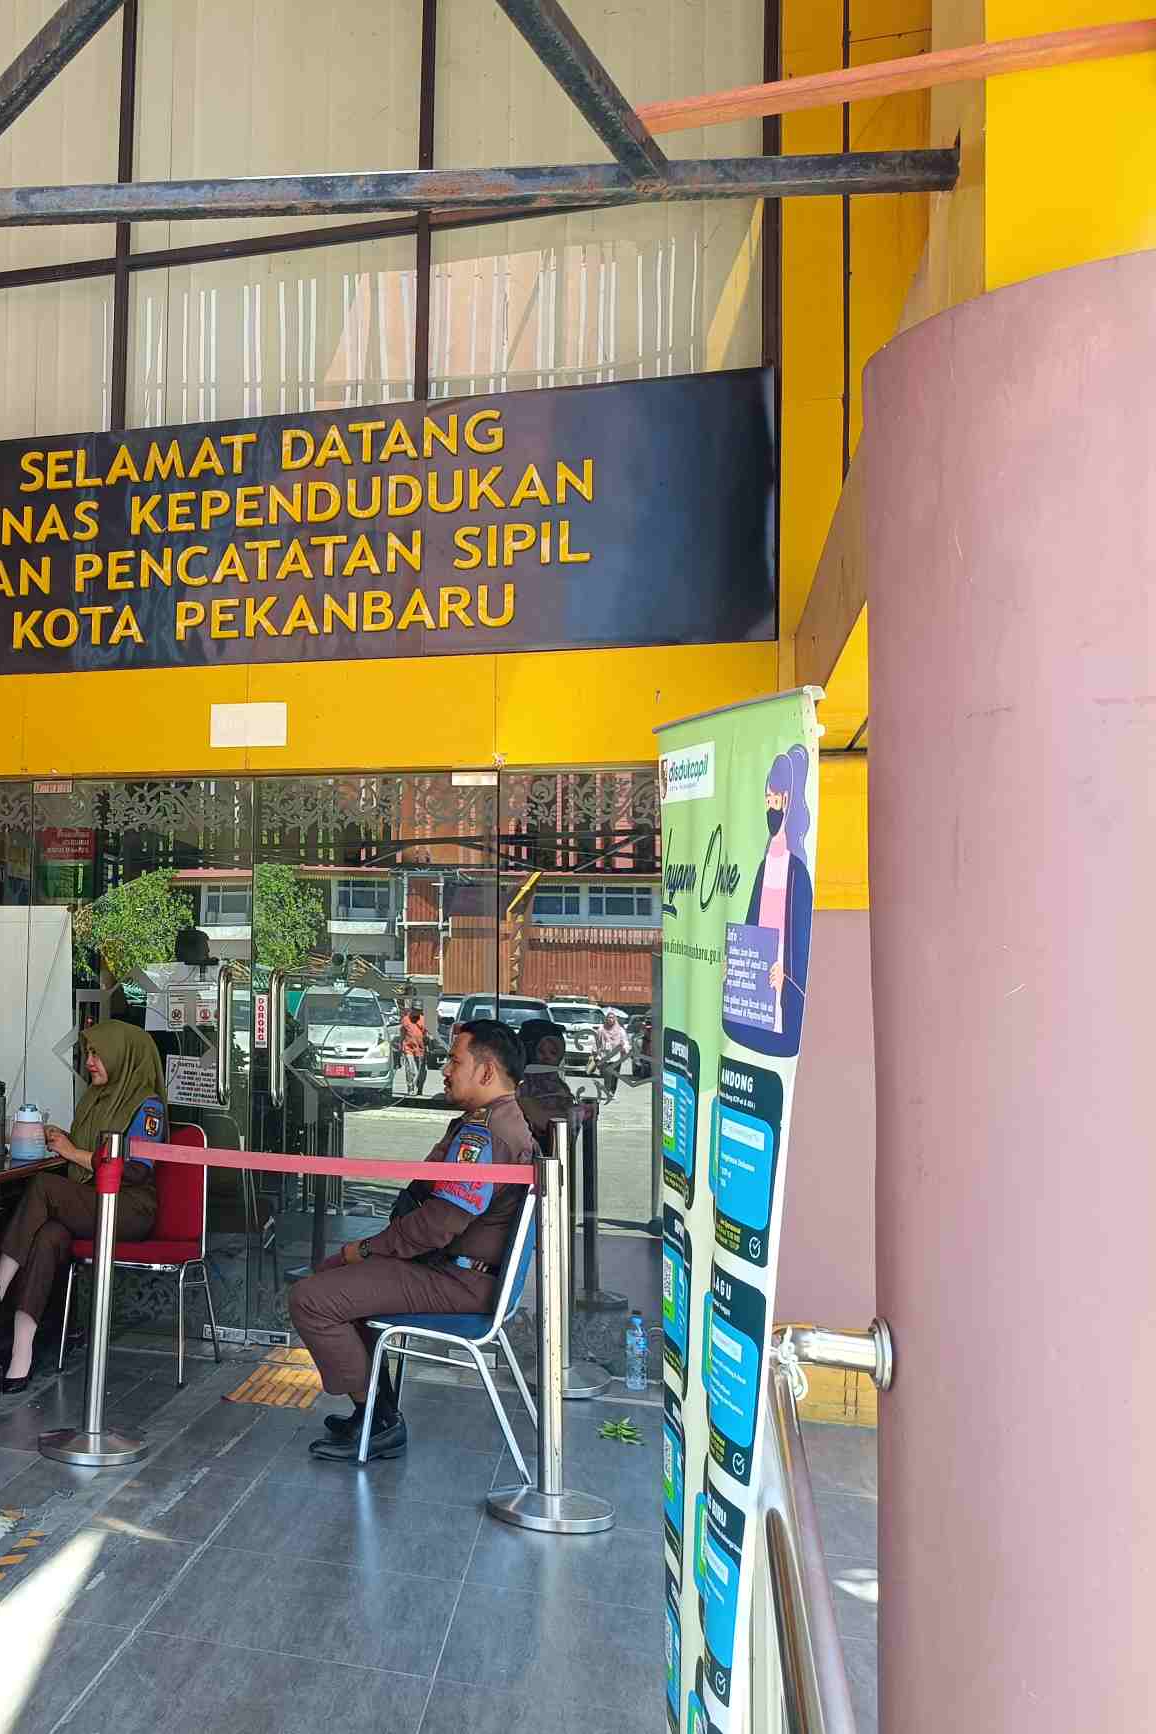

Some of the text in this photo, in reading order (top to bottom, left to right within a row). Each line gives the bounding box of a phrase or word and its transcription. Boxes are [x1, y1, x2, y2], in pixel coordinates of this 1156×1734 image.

[19, 408, 505, 493] SELAMAT DATANG
[130, 458, 595, 537] KEPENDUDUKAN
[74, 530, 422, 594] PENCATATAN
[452, 519, 592, 571] SIPIL
[11, 583, 516, 651] KOTA PEKANBARU
